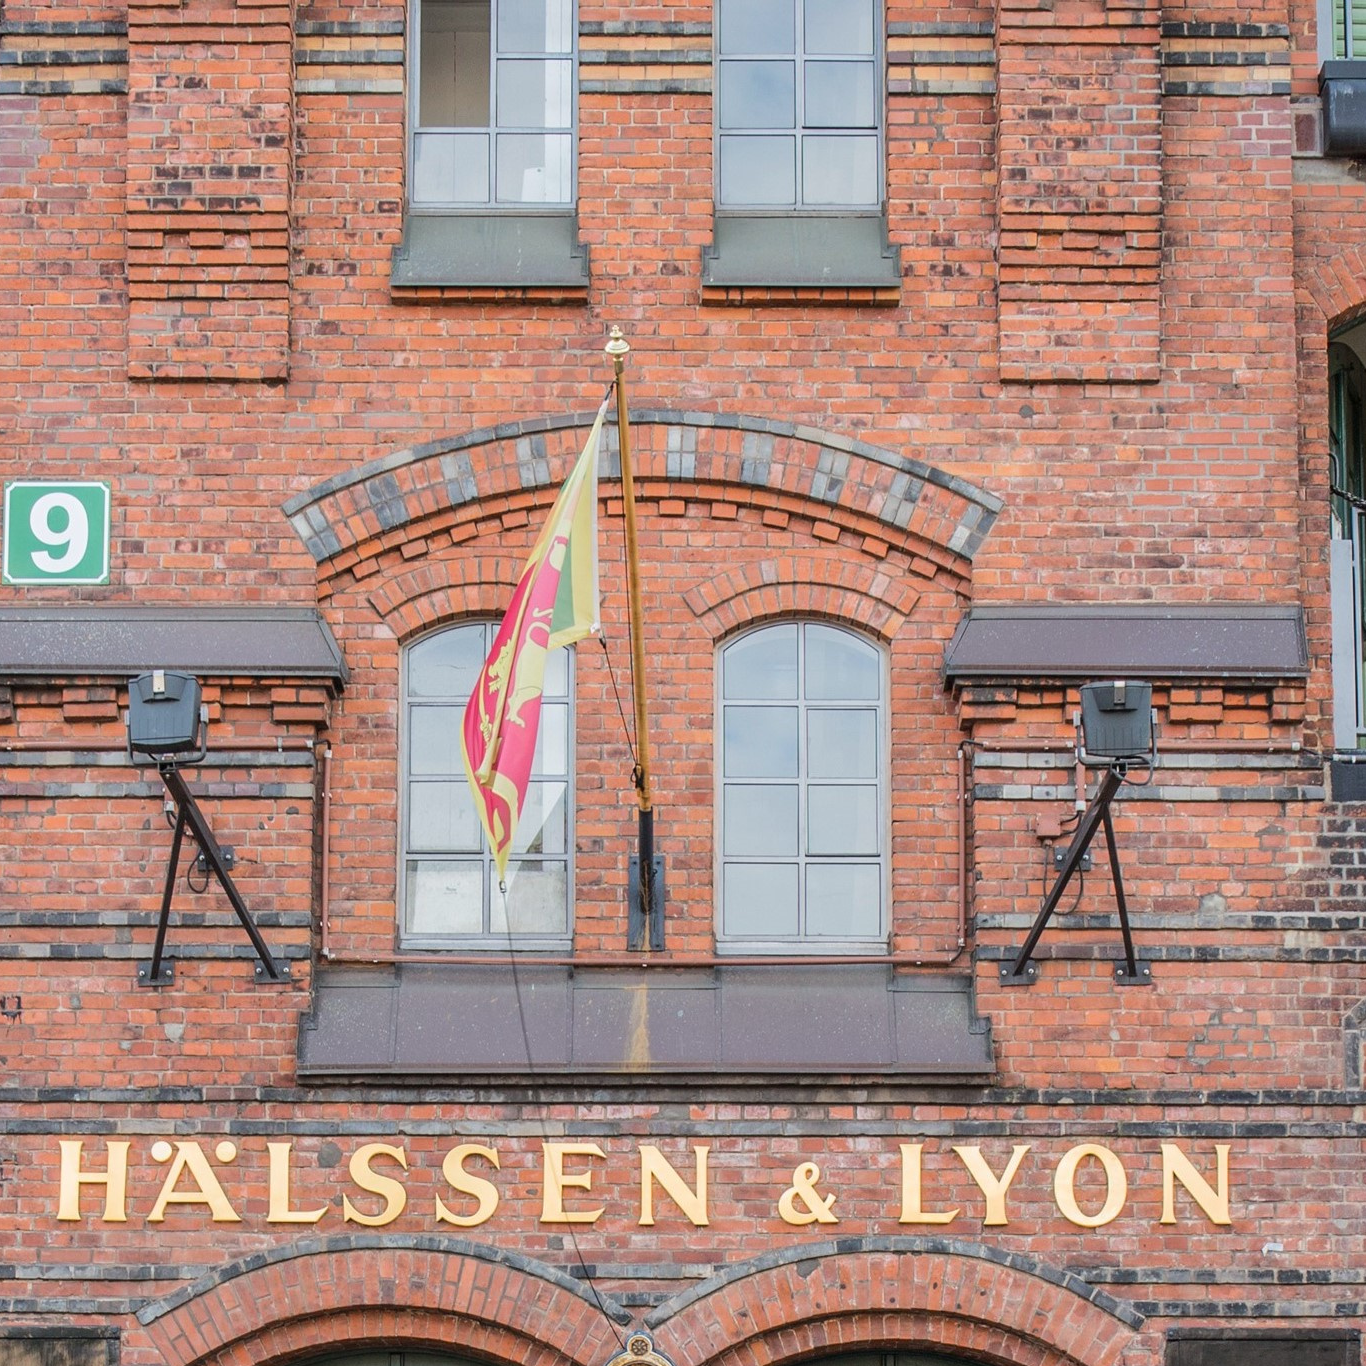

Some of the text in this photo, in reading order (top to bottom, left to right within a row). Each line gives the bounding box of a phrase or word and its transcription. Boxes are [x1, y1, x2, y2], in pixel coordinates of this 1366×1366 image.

[29, 491, 89, 574] 9
[56, 1139, 1247, 1227] HÄLSSEN & LYON
